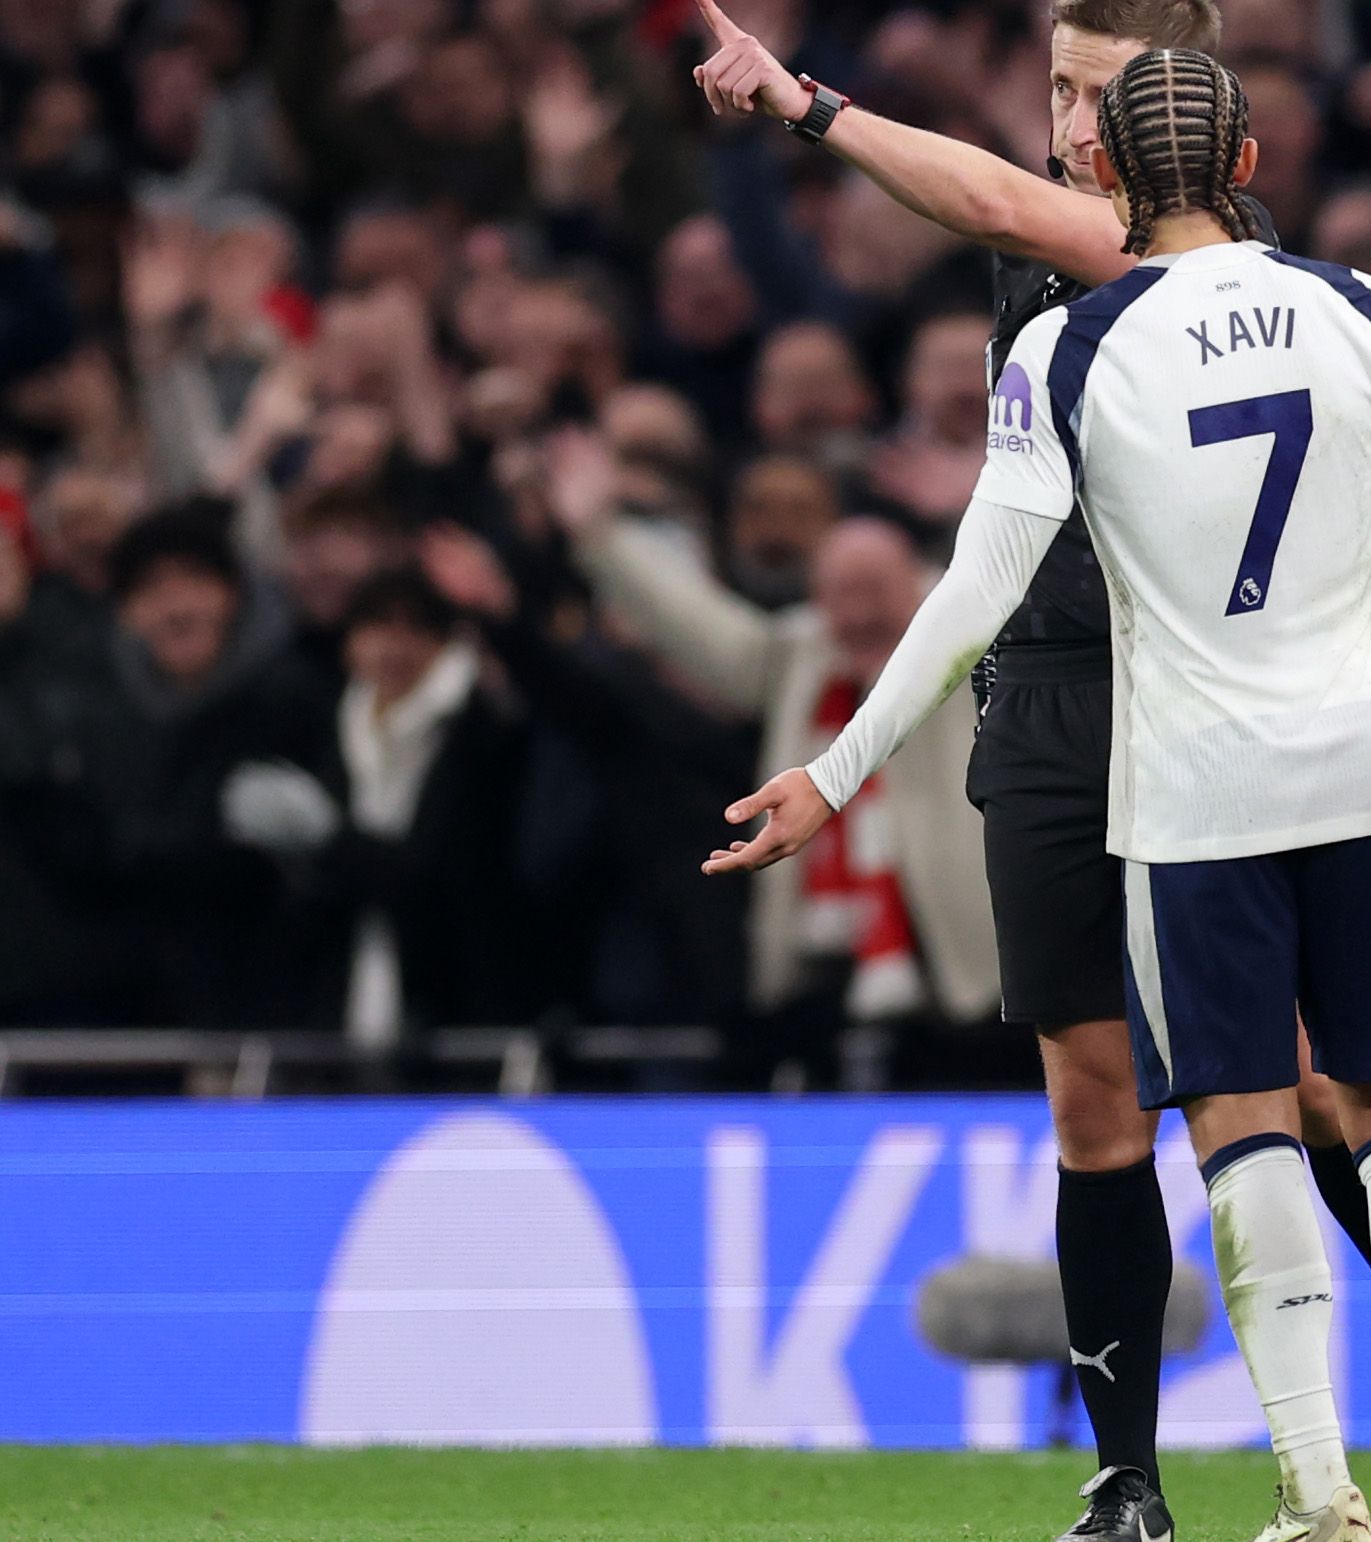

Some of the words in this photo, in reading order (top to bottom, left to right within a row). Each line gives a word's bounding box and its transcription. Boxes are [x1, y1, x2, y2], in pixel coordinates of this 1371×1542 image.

[1215, 280, 1241, 292] 898
[1185, 306, 1295, 366] XAVI
[1187, 388, 1314, 617] 7
[1275, 1293, 1333, 1310] SPU
